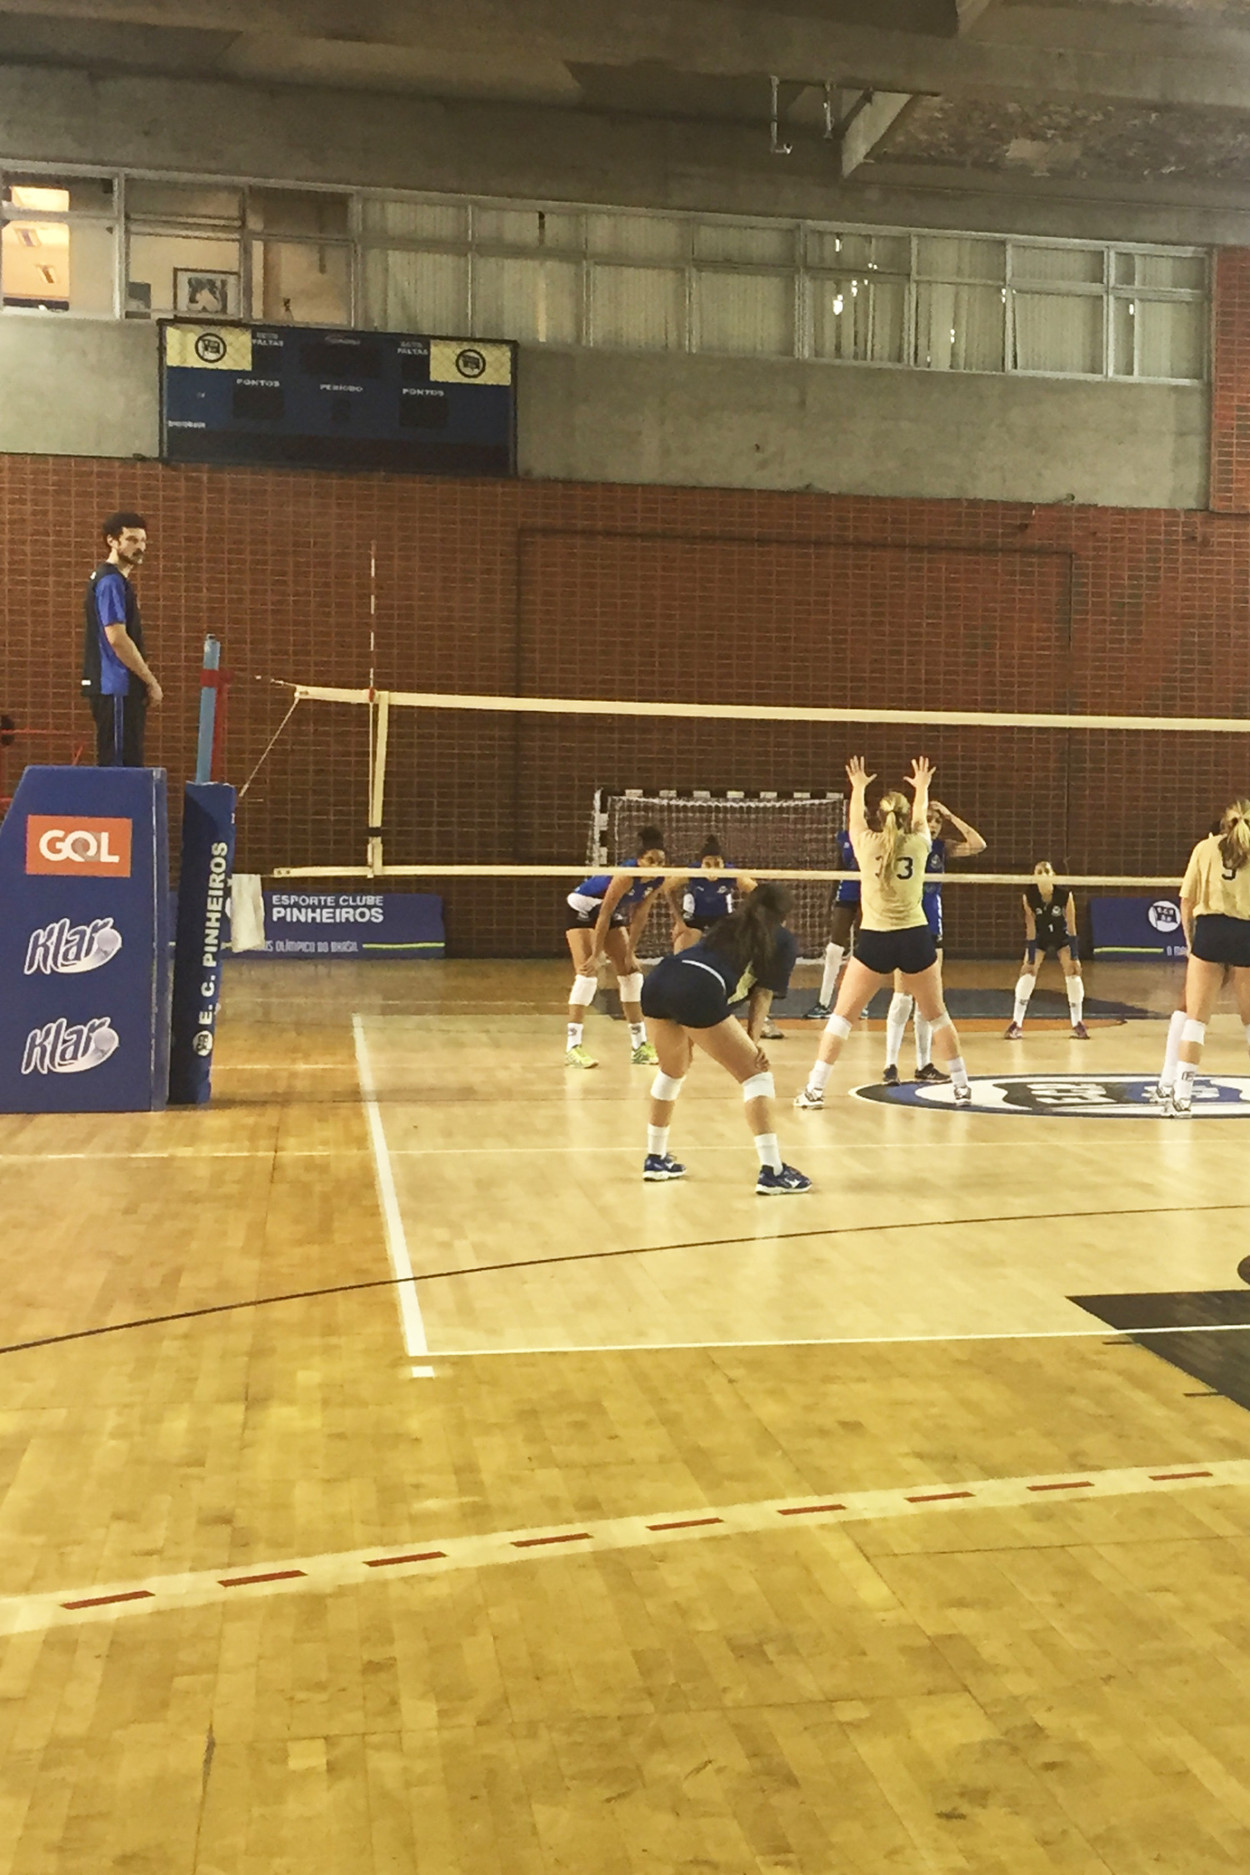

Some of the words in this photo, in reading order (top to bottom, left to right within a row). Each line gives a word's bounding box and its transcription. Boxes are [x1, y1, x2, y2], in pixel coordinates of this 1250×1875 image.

[39, 829, 120, 863] GOL
[202, 842, 228, 967] PINHEIROS
[272, 894, 336, 906] ESPORTE
[339, 895, 384, 906] CLUBE
[272, 907, 384, 923] PINHEIROS
[201, 975, 216, 997] C.
[198, 1004, 213, 1025] E.
